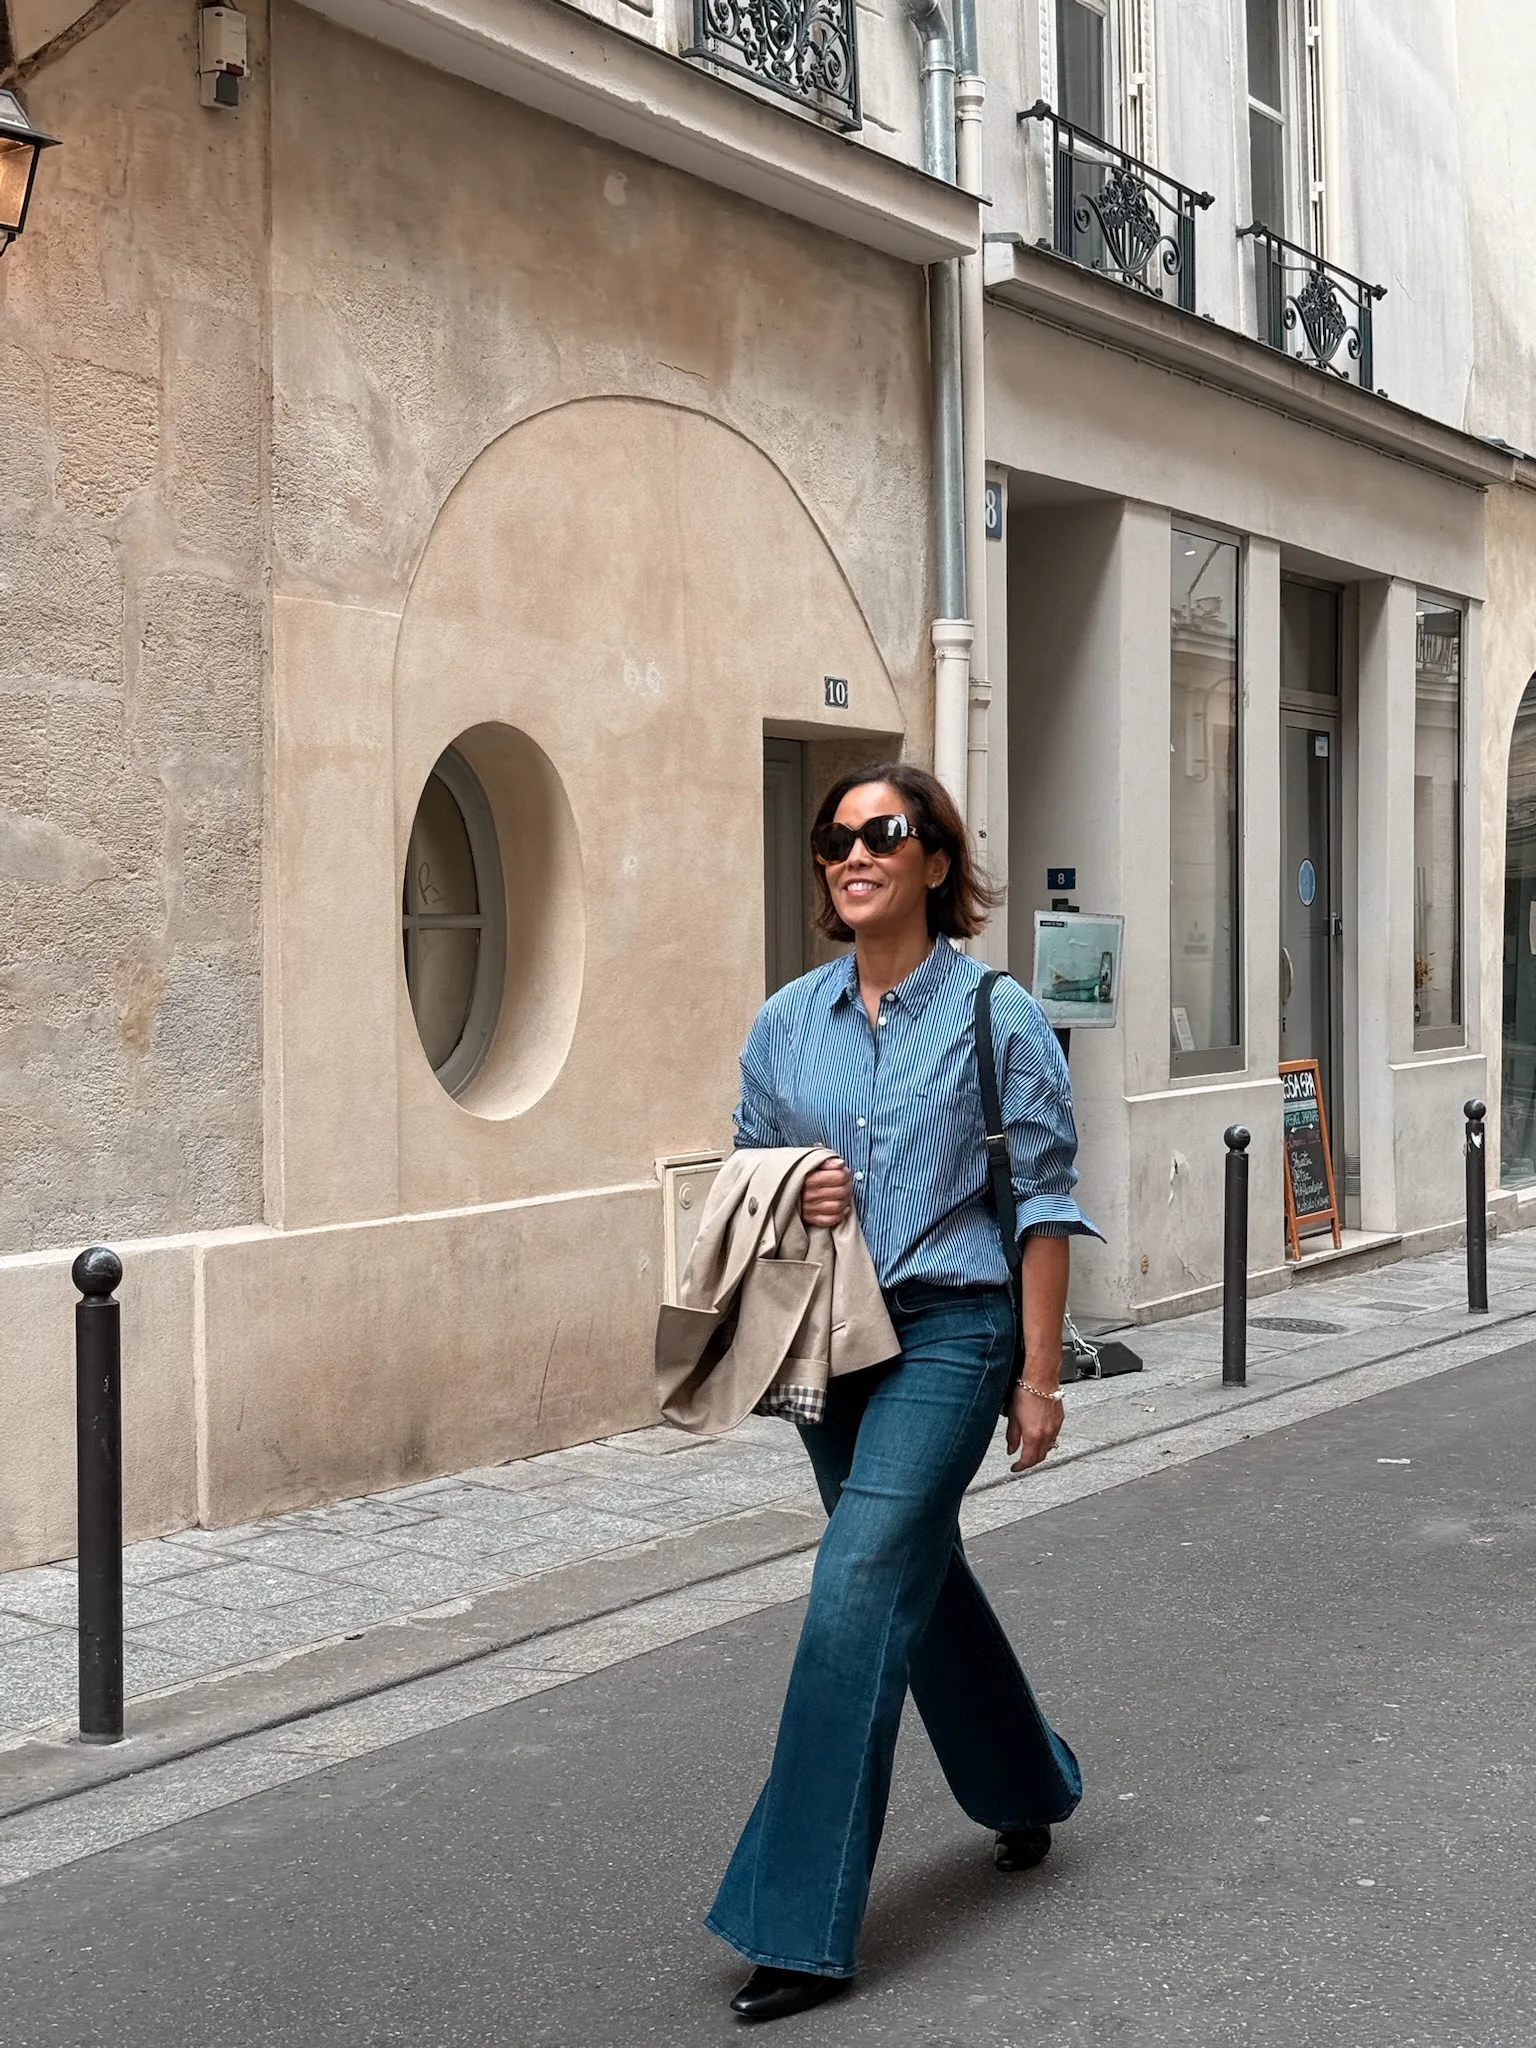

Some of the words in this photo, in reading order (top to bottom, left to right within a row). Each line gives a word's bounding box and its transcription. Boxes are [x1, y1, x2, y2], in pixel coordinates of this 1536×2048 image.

[986, 489, 997, 529] 8
[828, 681, 846, 704] 10
[1057, 872, 1066, 885] 8
[1283, 1073, 1303, 1099] SSA
[1300, 1071, 1316, 1097] SPA
